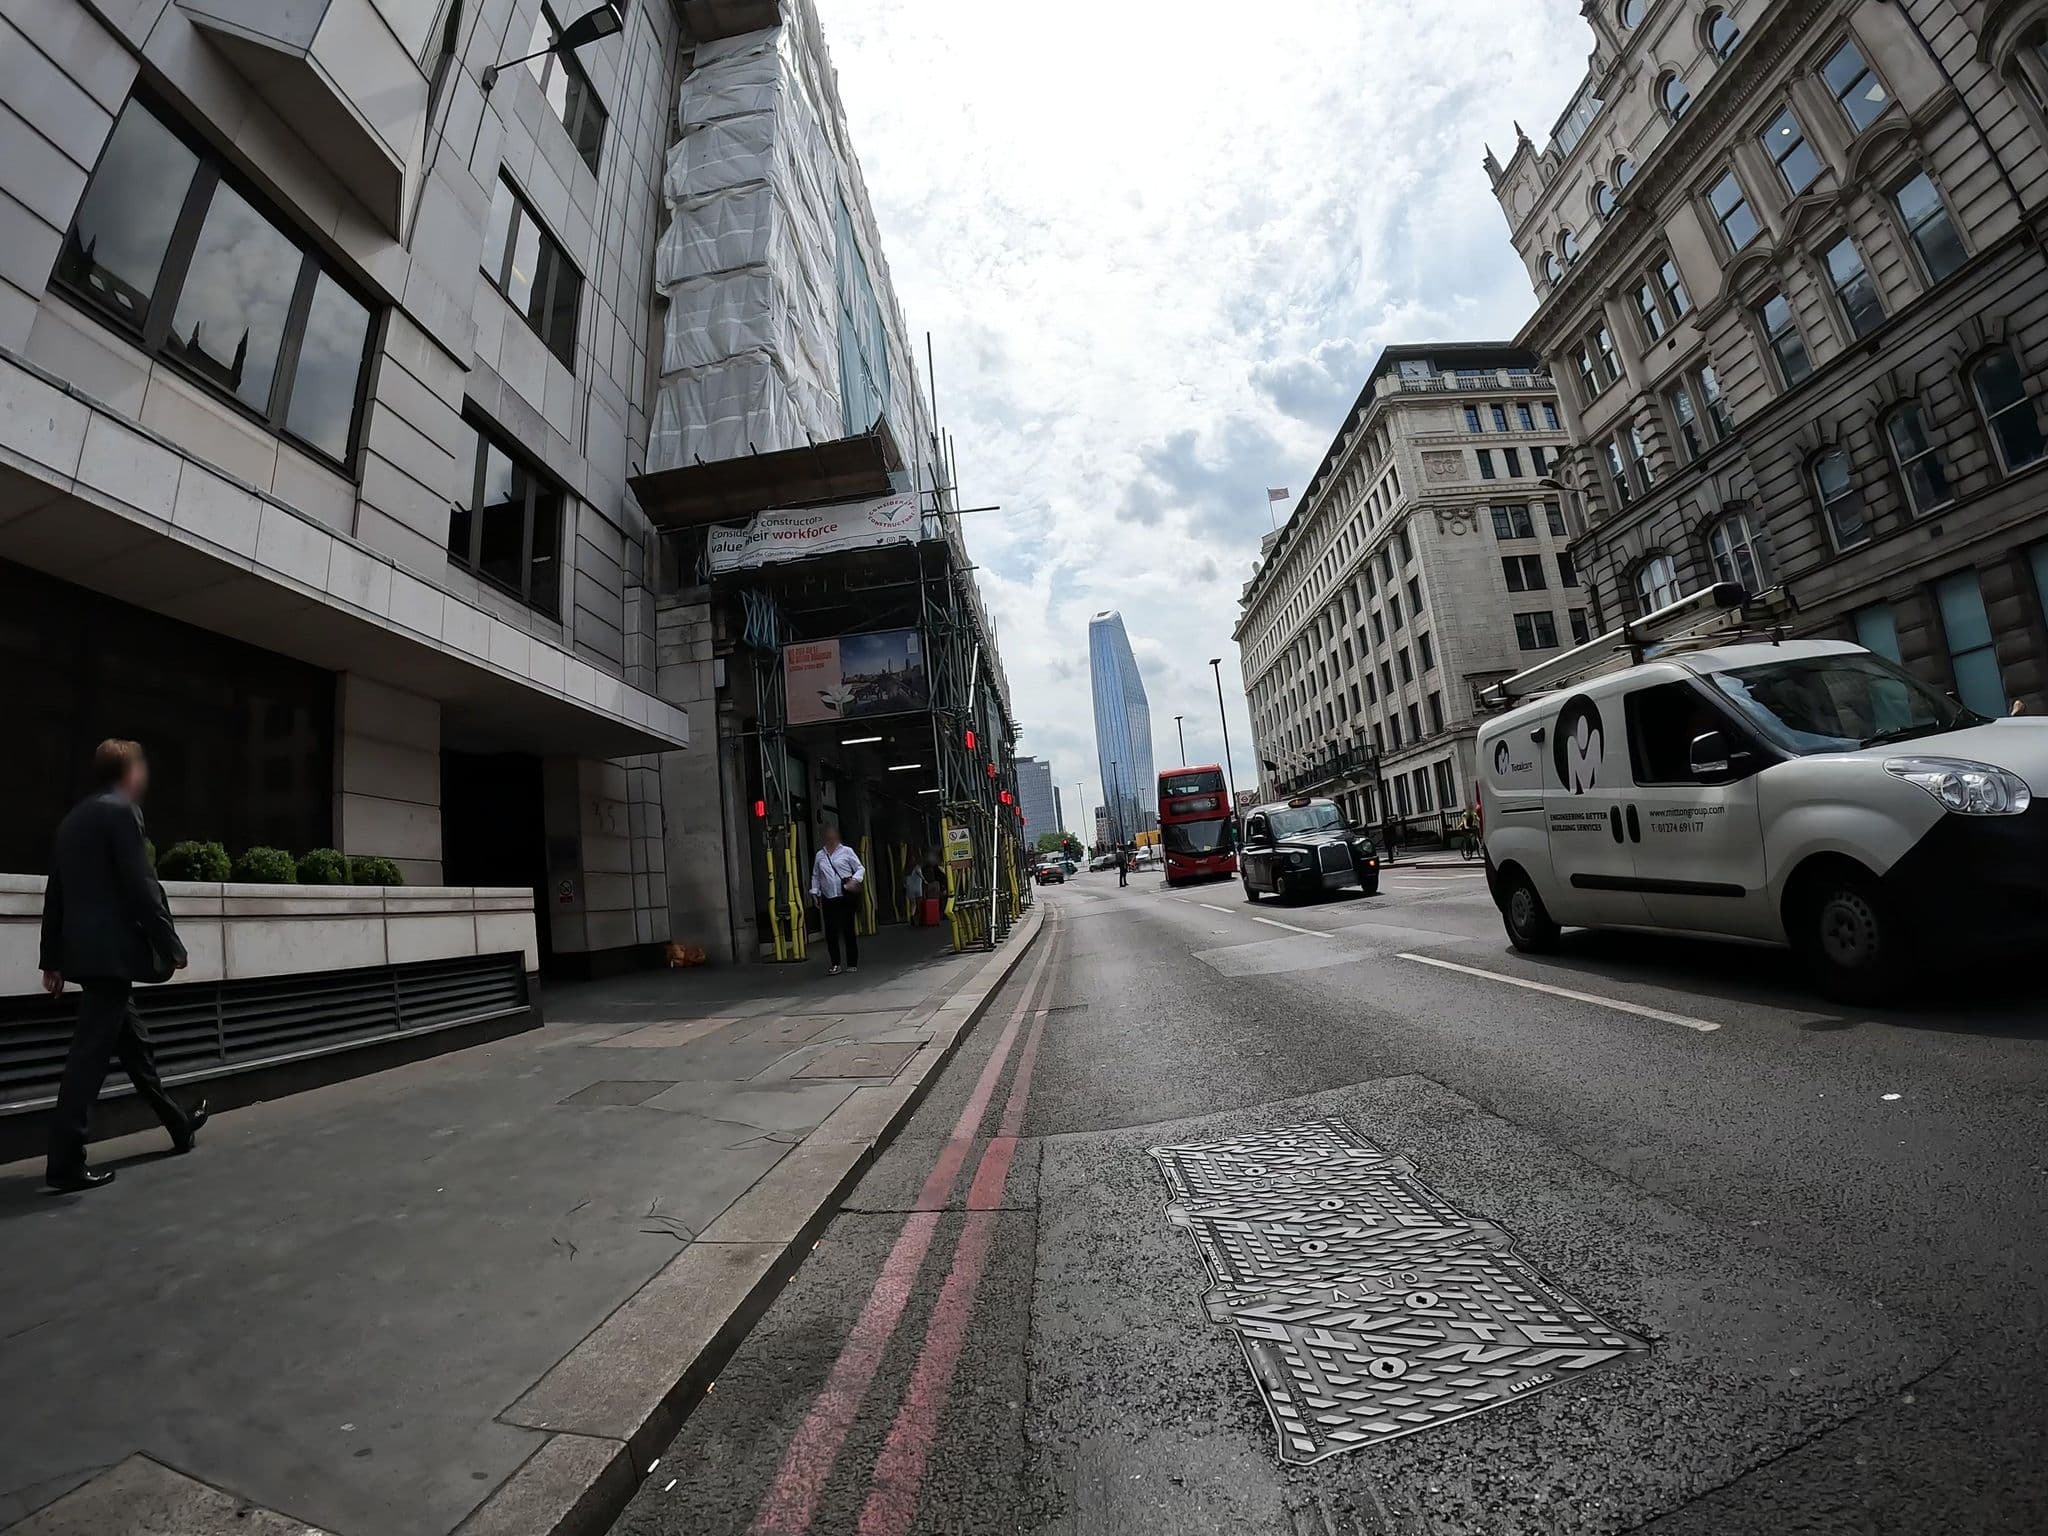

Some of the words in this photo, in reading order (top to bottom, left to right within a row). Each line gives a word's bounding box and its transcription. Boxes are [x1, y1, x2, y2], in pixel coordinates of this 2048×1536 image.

[761, 516, 823, 527] constructors
[711, 541, 742, 553] value
[773, 523, 838, 539] workforce
[1551, 824, 1576, 832] BUILDING
[1577, 823, 1602, 831] SERVICES
[1680, 821, 1704, 832] 691177
[1510, 1371, 1555, 1393] unite
